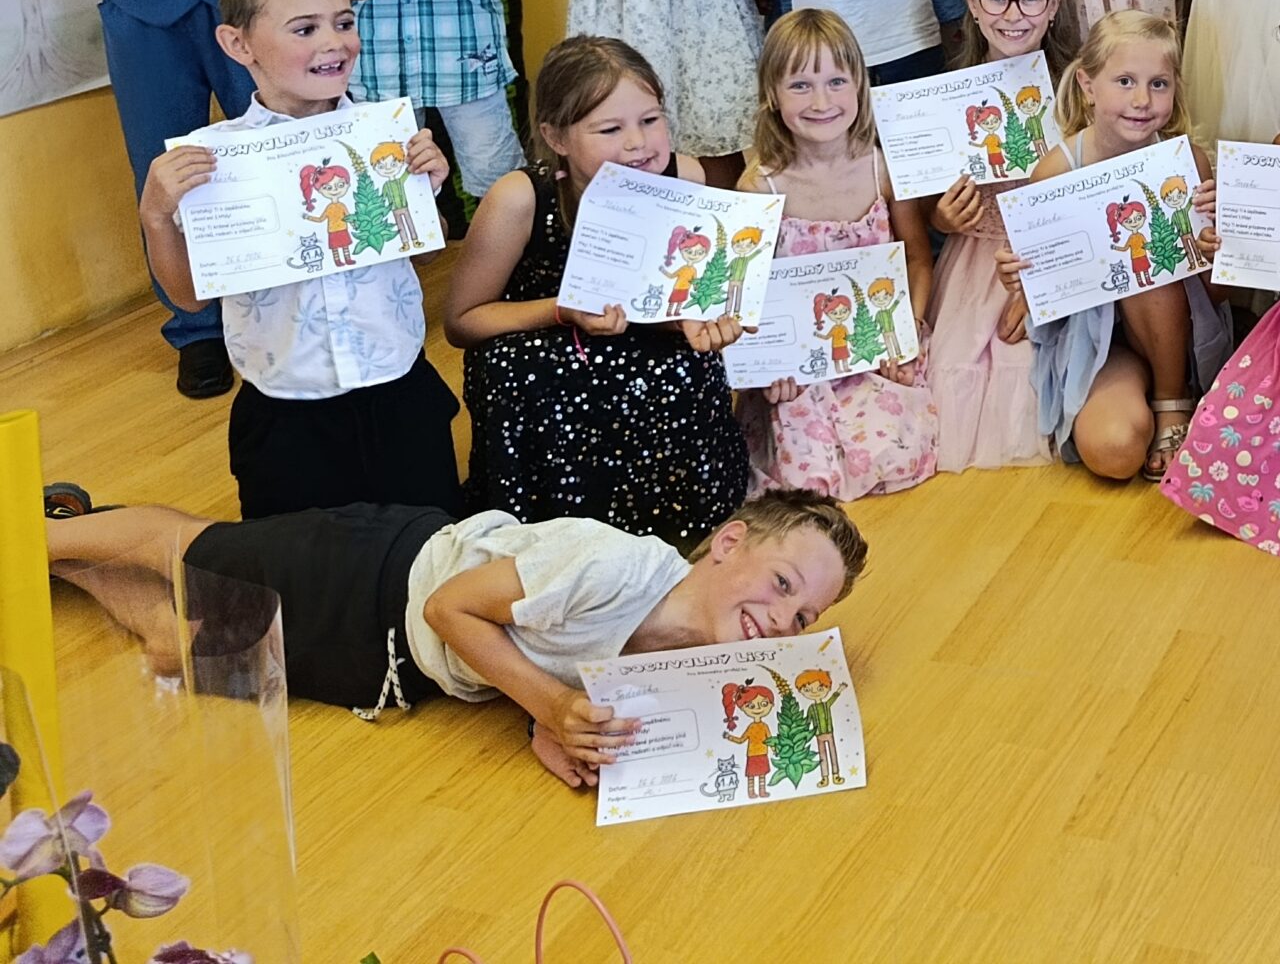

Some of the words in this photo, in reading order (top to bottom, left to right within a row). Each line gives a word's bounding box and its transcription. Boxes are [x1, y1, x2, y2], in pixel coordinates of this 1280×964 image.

[896, 79, 973, 102] POCHVALNÝ
[976, 71, 1004, 86] LIST
[314, 122, 355, 140] LIST
[618, 178, 695, 207] POCHVALNÝ
[697, 197, 732, 213] LIST
[1028, 172, 1111, 206] POCHVALNÝ
[1114, 162, 1145, 180] LIST
[828, 259, 858, 273] LIST
[619, 653, 732, 676] POCHVALNÝ
[735, 649, 777, 664] LIST
